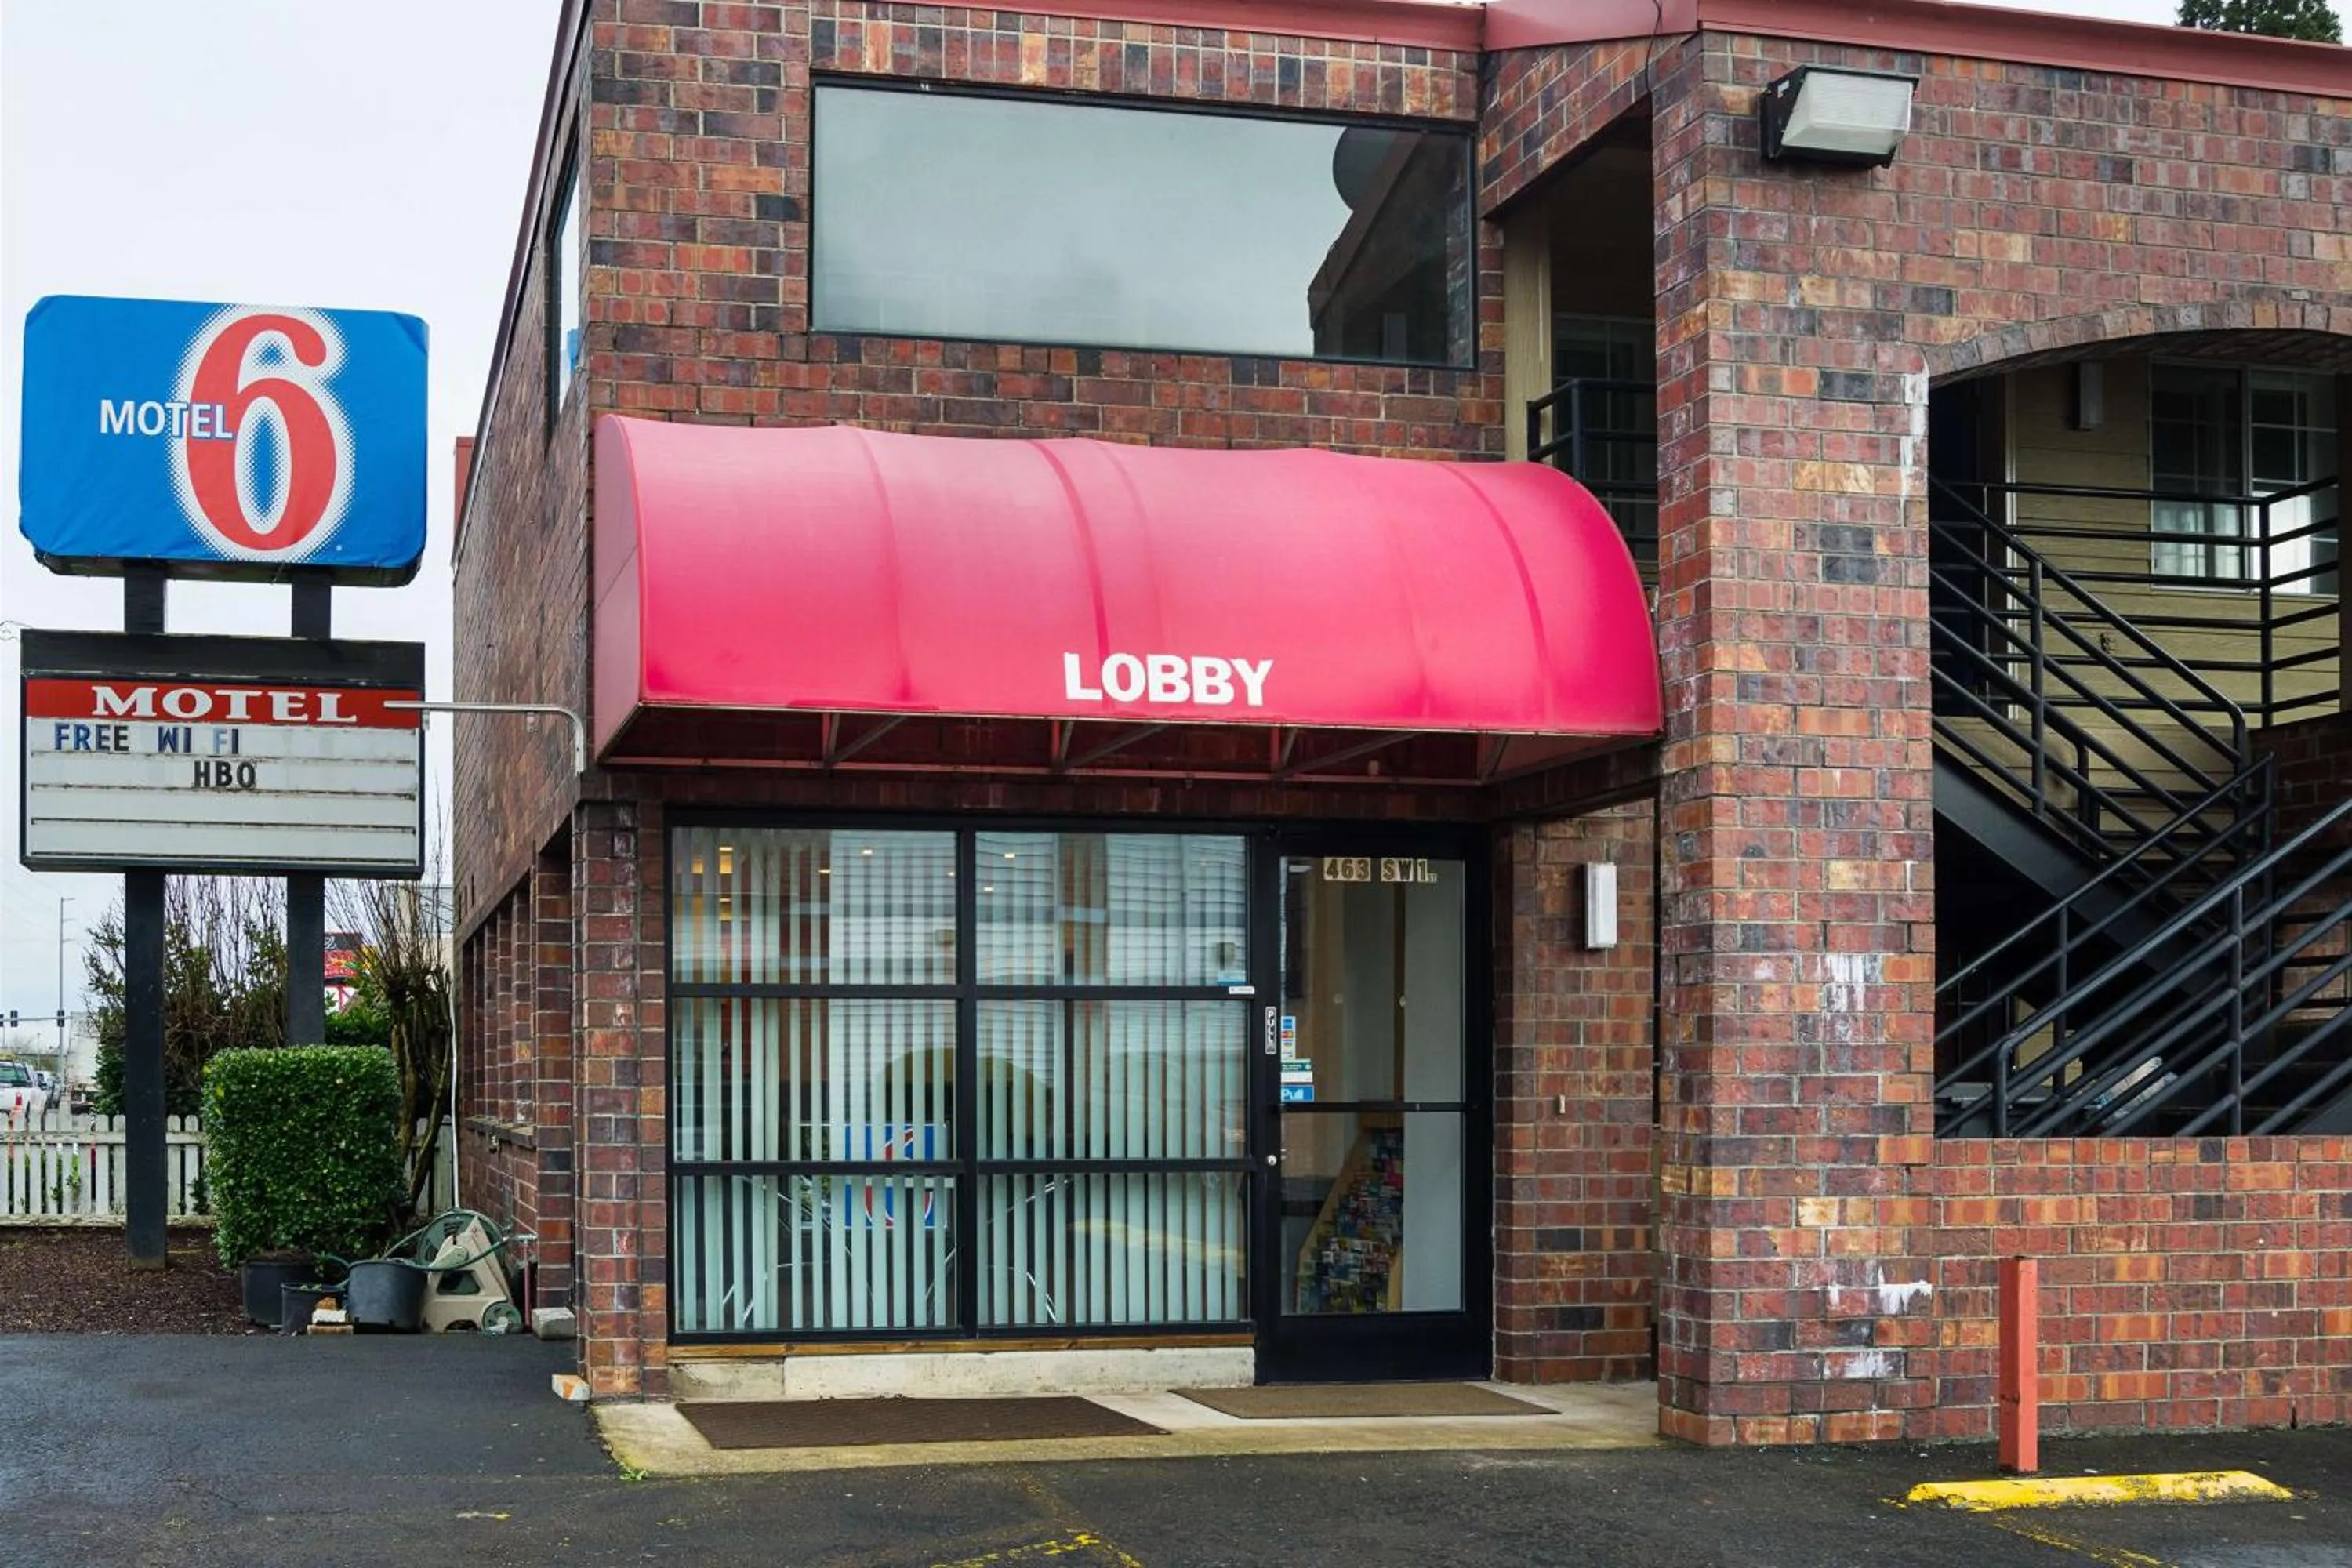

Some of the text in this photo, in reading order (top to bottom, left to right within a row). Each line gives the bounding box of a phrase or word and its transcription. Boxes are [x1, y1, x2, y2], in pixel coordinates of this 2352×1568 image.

[100, 314, 336, 551] MOTEL 6
[1063, 652, 1274, 706] LOBBY
[92, 686, 357, 722] MOTEL
[54, 724, 239, 755] FREE WI FI
[194, 760, 256, 787] HBO
[1325, 858, 1369, 880] 463
[1382, 858, 1412, 880] SW
[1267, 1011, 1276, 1043] PULL
